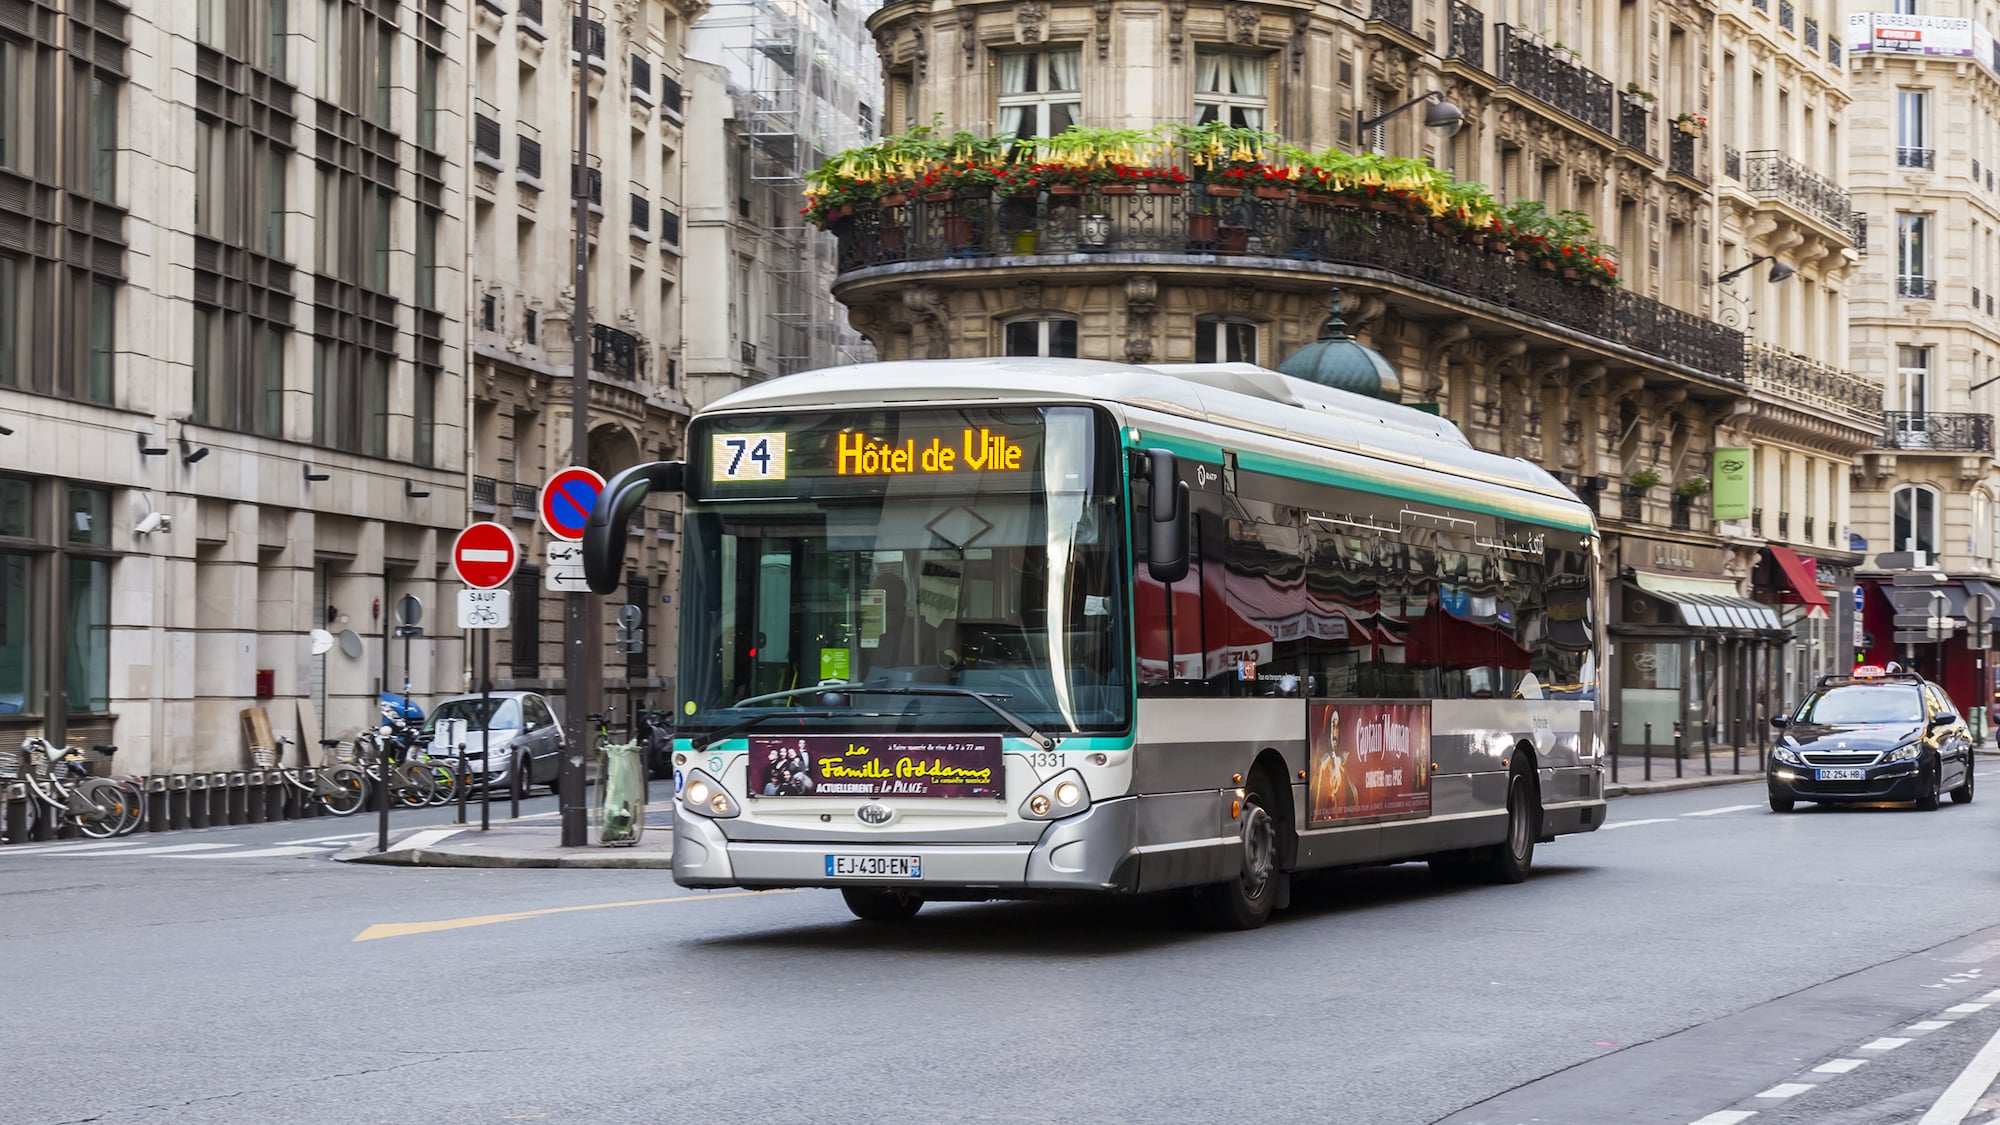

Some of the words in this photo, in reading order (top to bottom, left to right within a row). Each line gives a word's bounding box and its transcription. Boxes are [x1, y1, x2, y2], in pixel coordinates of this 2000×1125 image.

[1876, 15, 1923, 27] BUREAUX
[1935, 20, 1969, 31] LOUER
[726, 438, 771, 476] 74
[837, 432, 914, 475] Hôtel
[921, 437, 956, 472] de
[963, 428, 1023, 471] Ville
[469, 592, 497, 602] SAUF
[1356, 715, 1383, 762] Captain
[1381, 713, 1410, 760] Morgan
[845, 743, 870, 756] La
[818, 757, 893, 778] Famille
[895, 756, 991, 778] Addams
[1030, 752, 1065, 768] 1331
[815, 783, 874, 794] ACTUELLEMENT
[837, 857, 909, 874] EJ-430-EN
